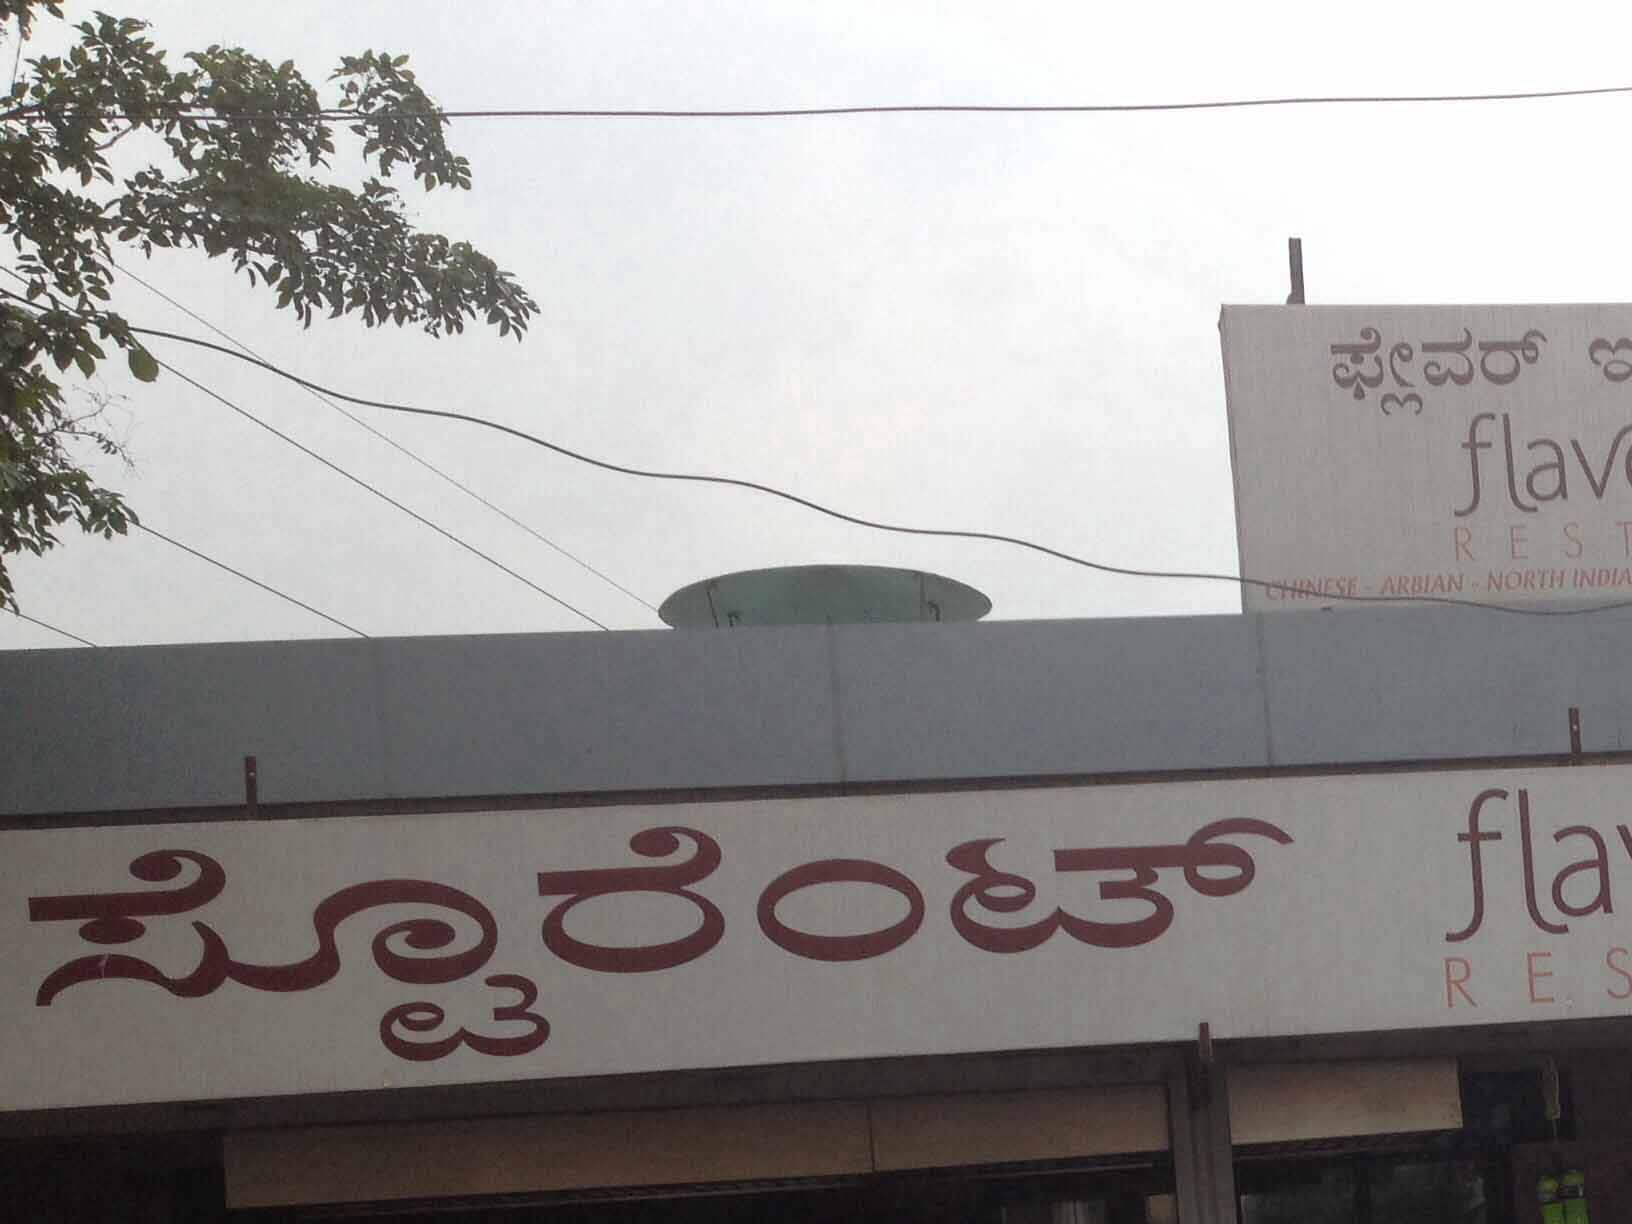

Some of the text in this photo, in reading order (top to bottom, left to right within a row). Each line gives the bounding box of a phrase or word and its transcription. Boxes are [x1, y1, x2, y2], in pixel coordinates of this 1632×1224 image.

[1266, 575, 1359, 600] CHINESE
[1381, 573, 1464, 596] ARBIAN
[1487, 569, 1565, 594] NORTH
